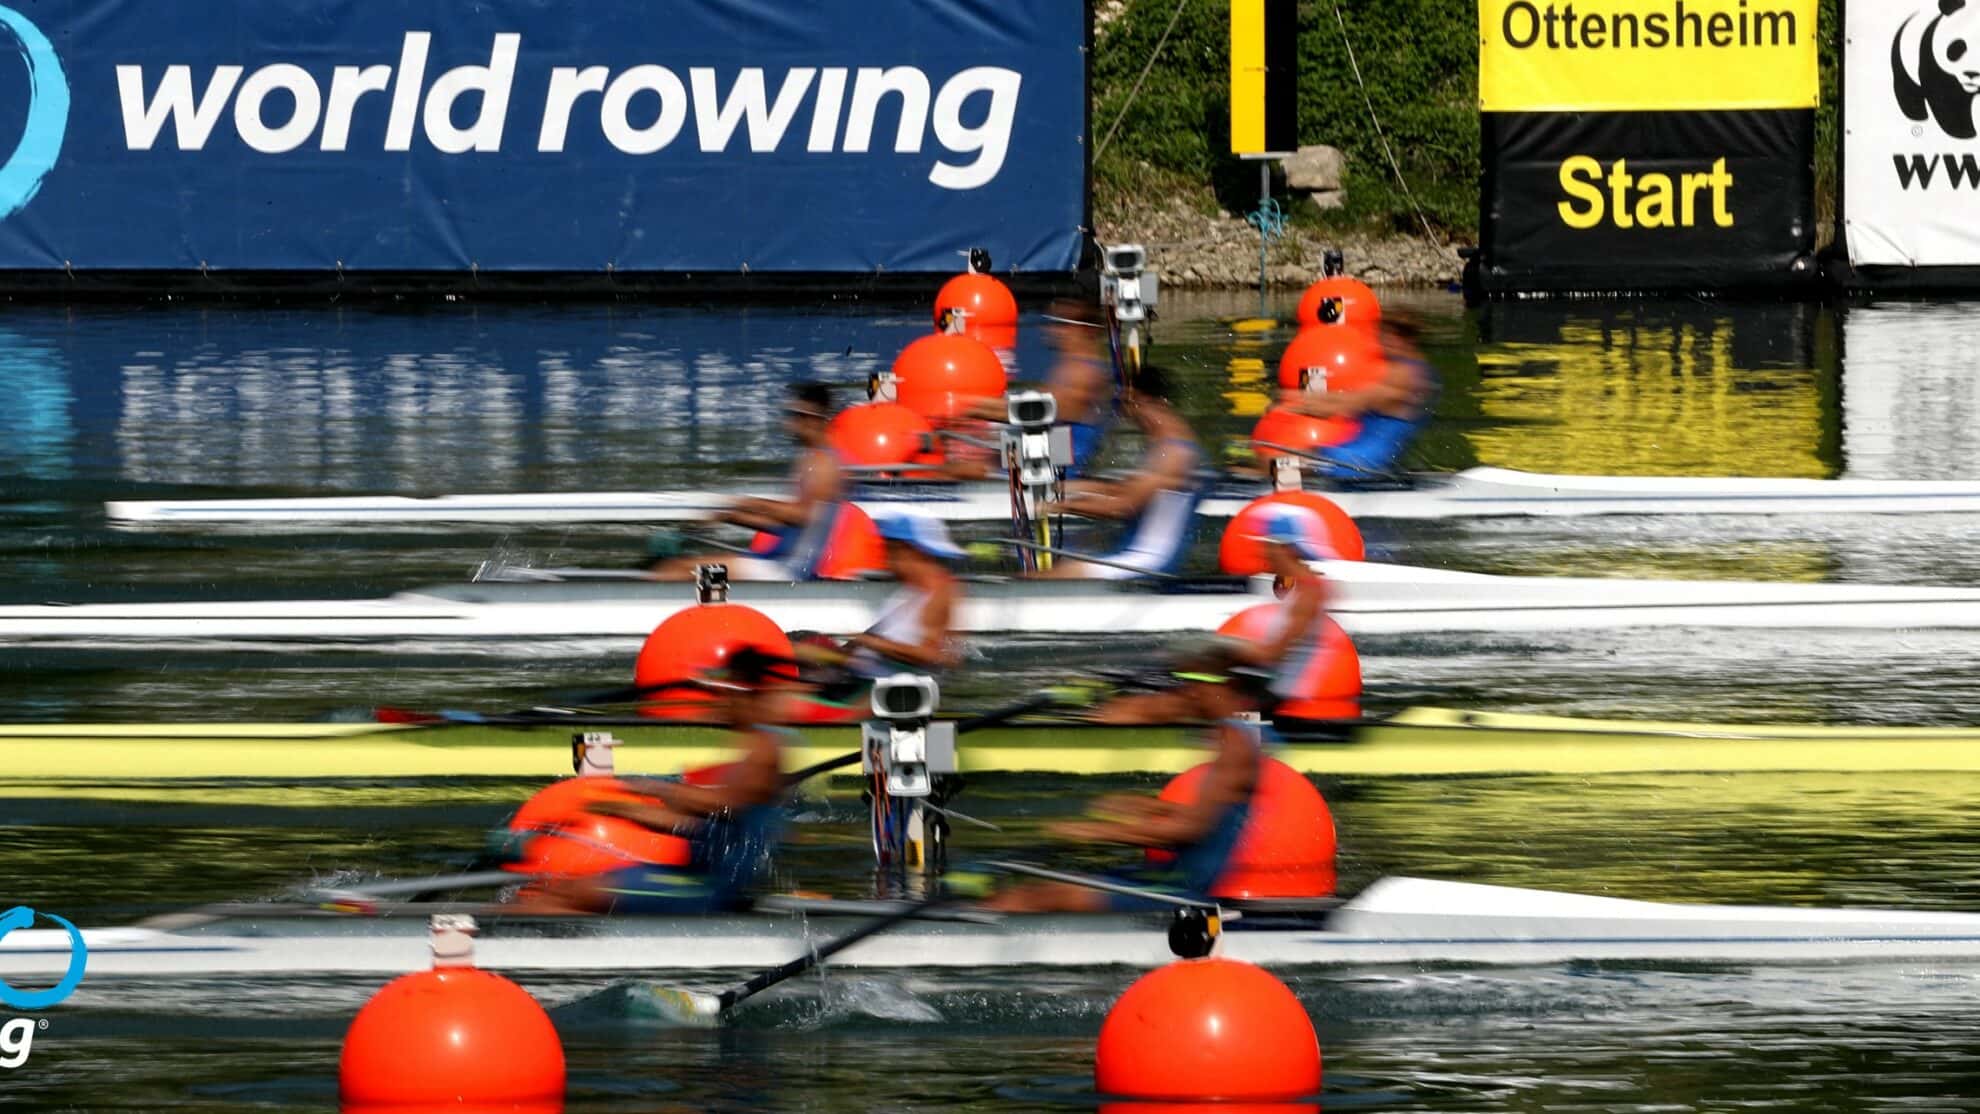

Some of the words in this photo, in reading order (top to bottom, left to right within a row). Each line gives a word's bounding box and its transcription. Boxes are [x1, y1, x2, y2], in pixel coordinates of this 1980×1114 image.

[1502, 0, 1797, 49] Ottensheim
[115, 31, 522, 154] world
[537, 64, 1022, 190] rowing
[1557, 154, 1735, 230] Start
